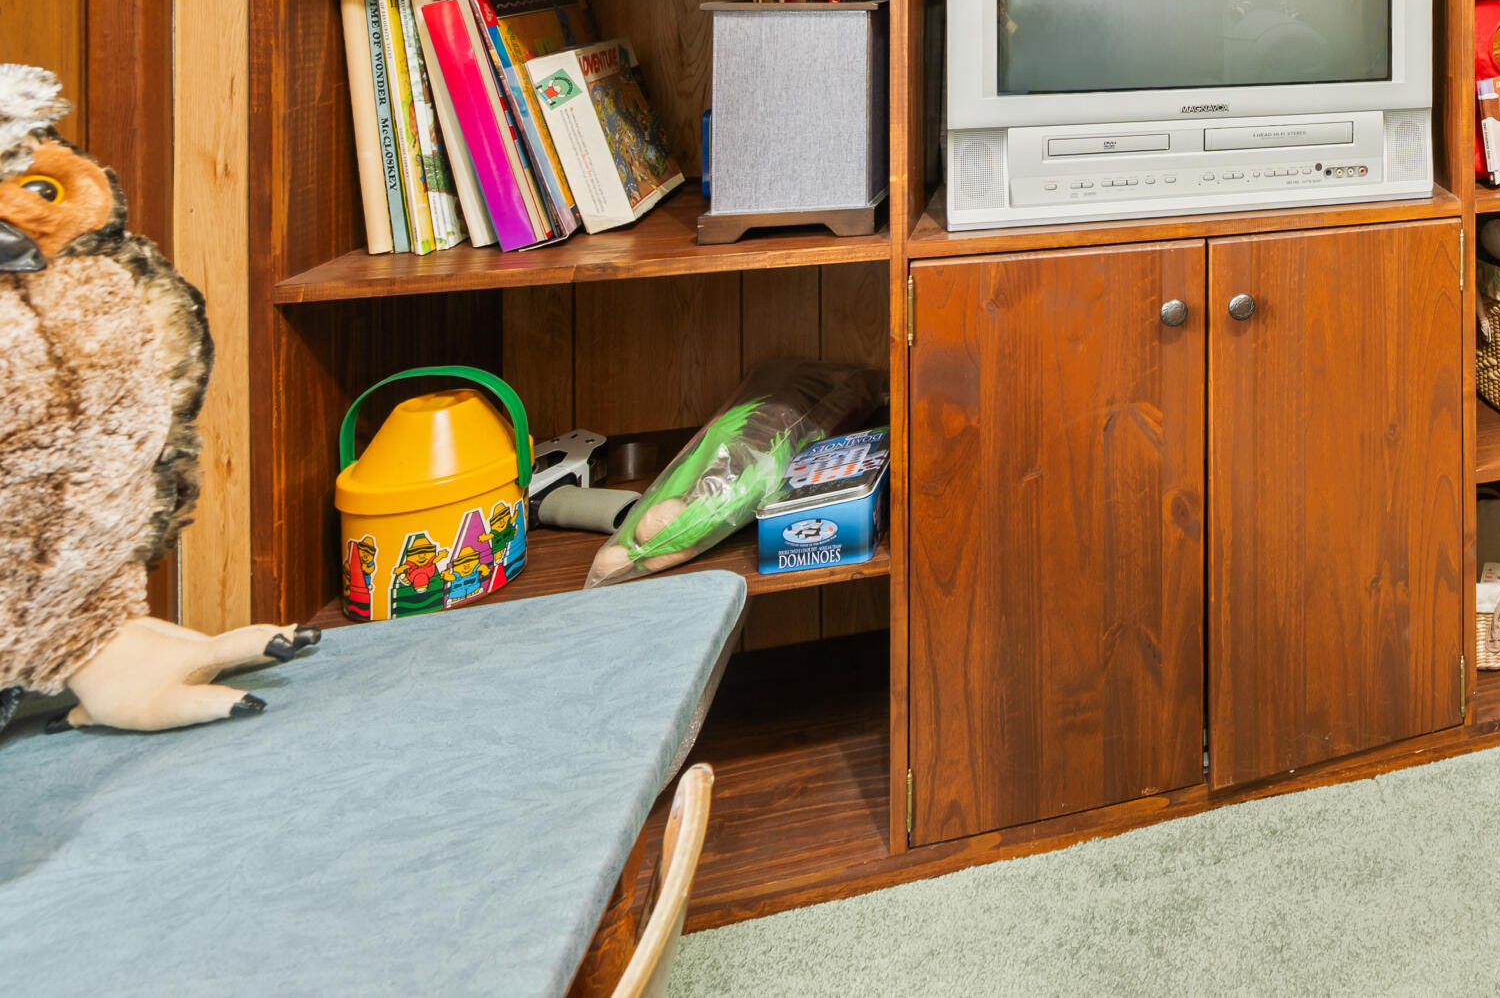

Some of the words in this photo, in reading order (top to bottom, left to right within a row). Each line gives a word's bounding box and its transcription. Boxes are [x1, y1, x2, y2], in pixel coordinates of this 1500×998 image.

[371, 28, 382, 49] OF
[373, 52, 388, 106] WONDER
[1180, 104, 1230, 113] MAGNAVOX
[380, 117, 398, 192] McCLOSKEY
[778, 548, 841, 569] DOMINOES
